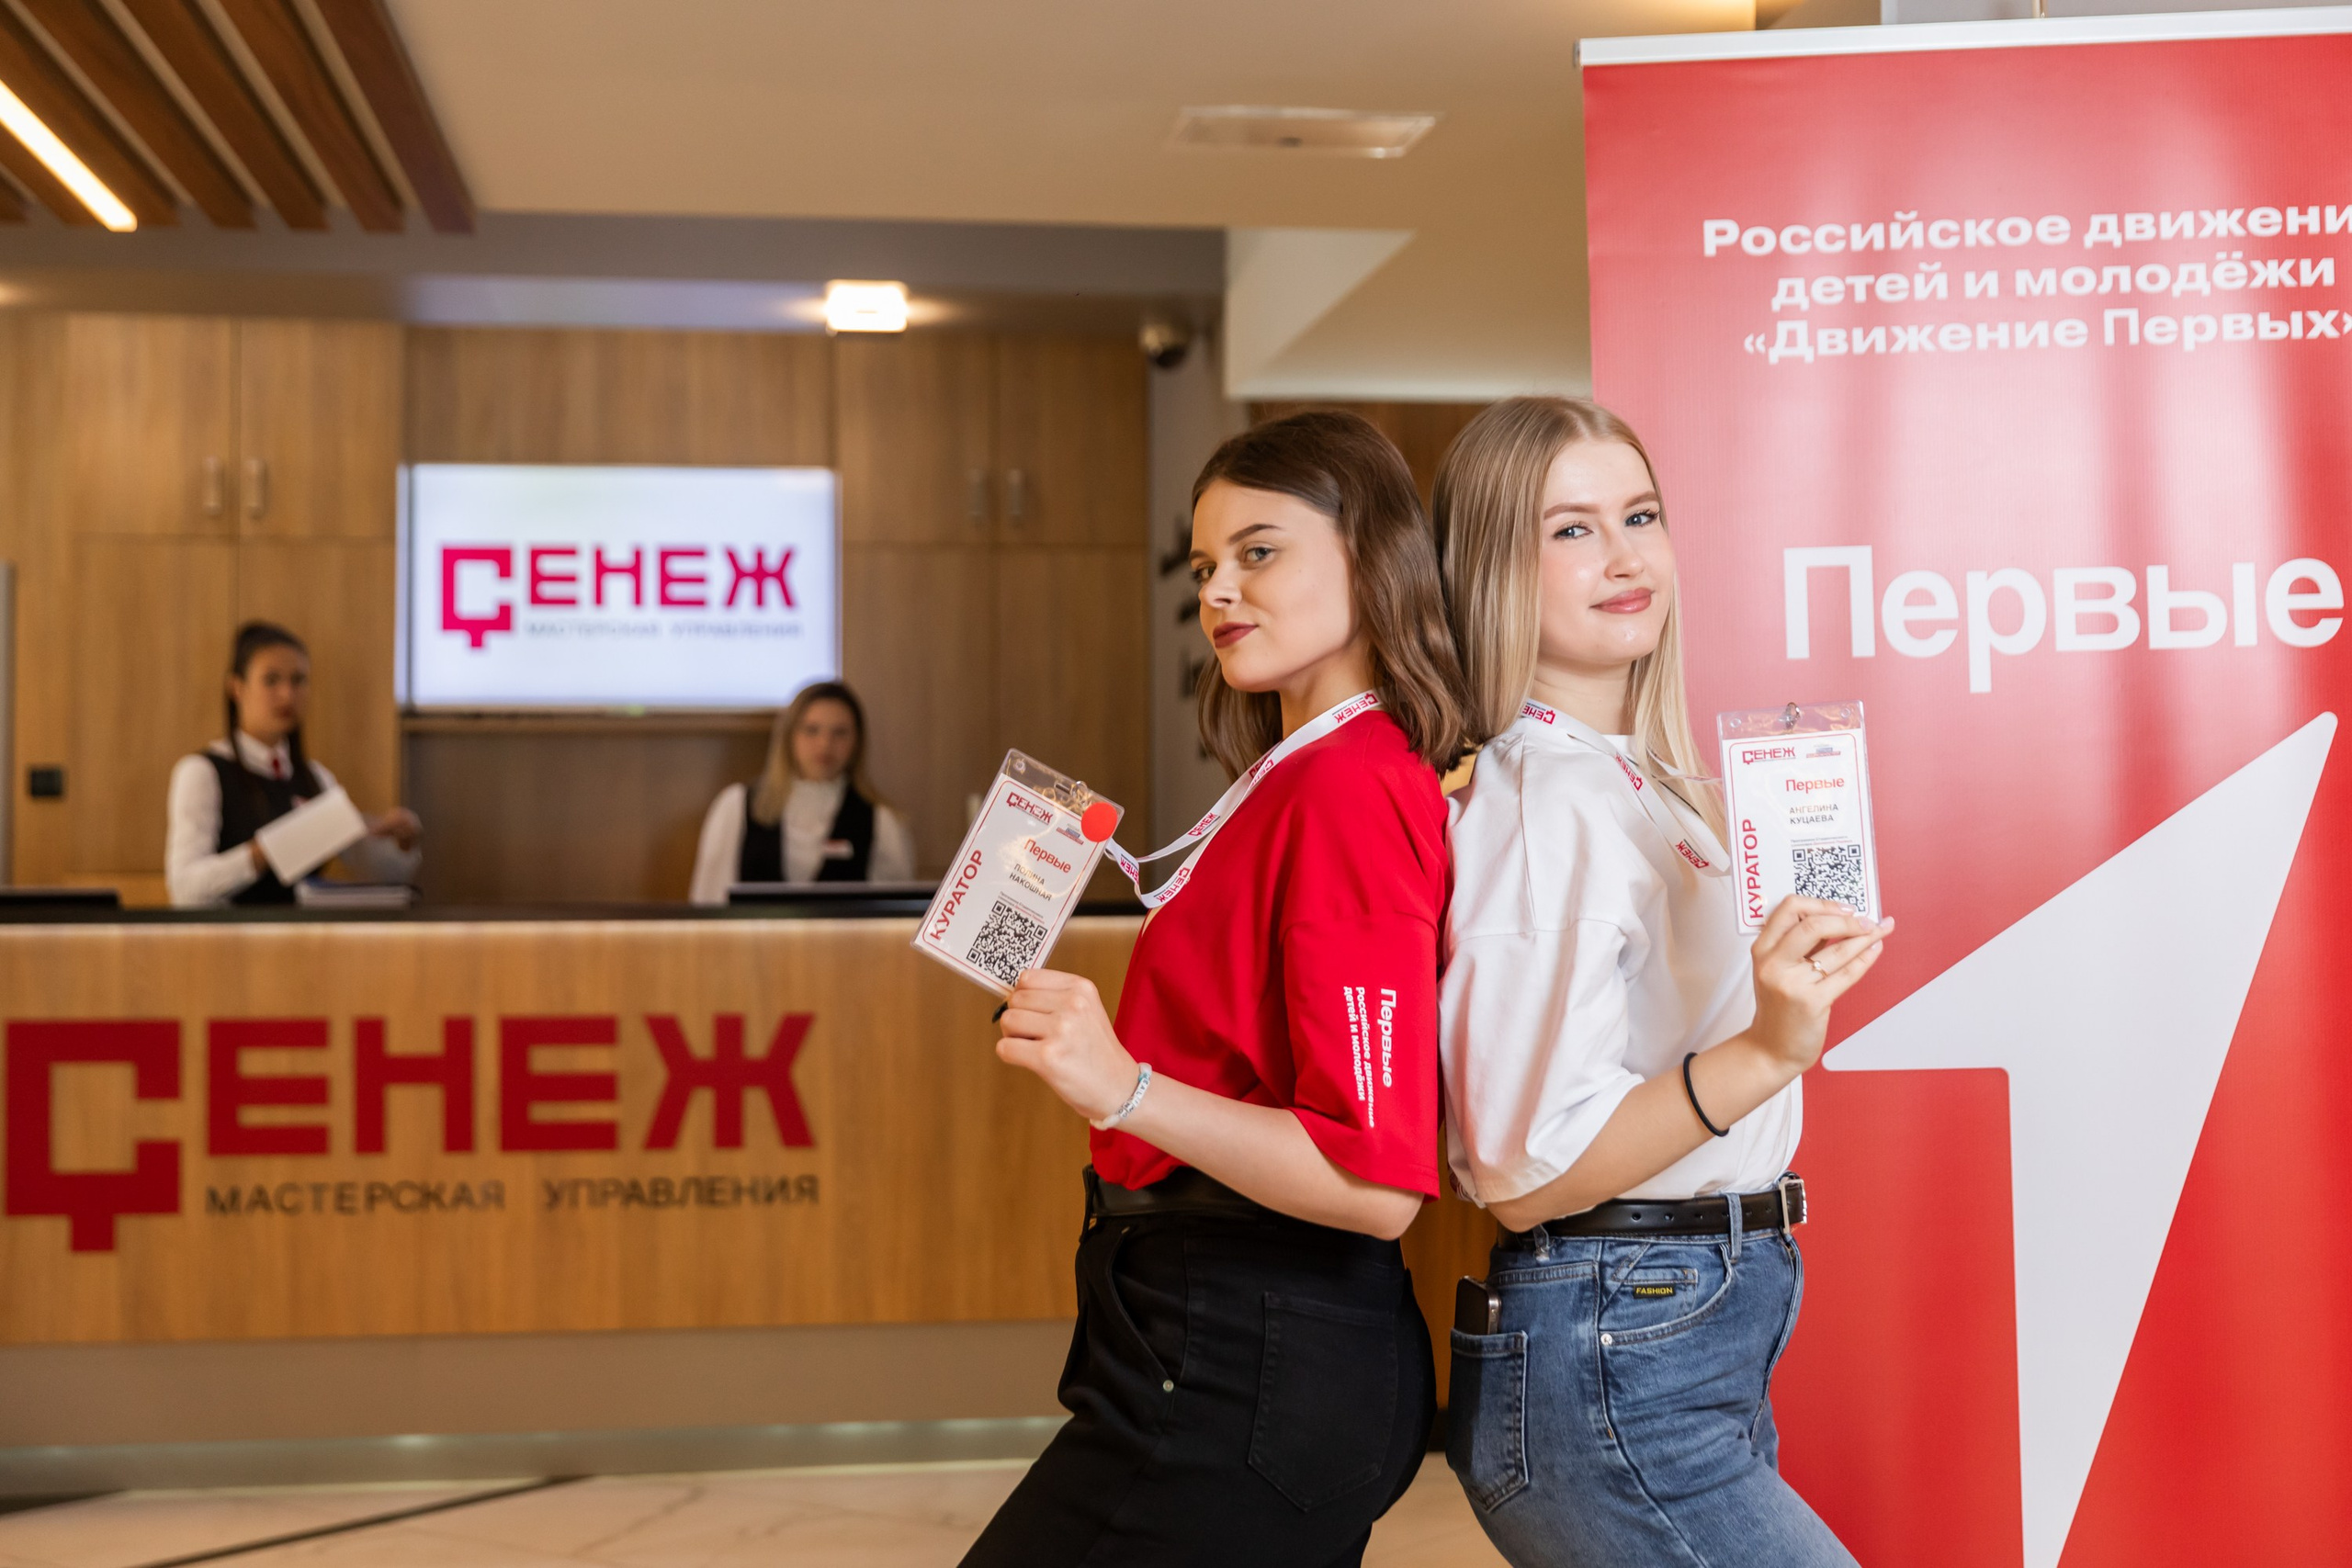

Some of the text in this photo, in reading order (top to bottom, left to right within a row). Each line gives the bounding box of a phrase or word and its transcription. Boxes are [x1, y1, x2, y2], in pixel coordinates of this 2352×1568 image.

[1702, 204, 2352, 257] Российское движени
[1771, 252, 2335, 311] детей и молодёжи
[1744, 315, 2088, 365] «Движение
[442, 546, 797, 649] СЕНЕЖ
[1783, 546, 2345, 694] Первые
[1334, 693, 1379, 724] СЕНЕЖ
[1521, 705, 1556, 725] СЕНЕ
[1742, 746, 1796, 765] СЕНЕЖ
[1785, 777, 1845, 795] Первые
[1006, 791, 1054, 826] СЕНЕЖ
[1188, 813, 1217, 836] СЕНЕЖ
[1789, 804, 1839, 815] АНГЕЛИНА
[1790, 815, 1834, 825] КУЦАЕВА
[1023, 839, 1071, 874] Первые
[1120, 857, 1140, 885] ЕНЕЖ
[1742, 818, 1764, 919] КУРАТОР
[1009, 873, 1053, 902] НАКОШНАЯ
[1013, 863, 1045, 886] ПОЛИНА
[1156, 867, 1191, 903] СЕНЕЖ
[930, 849, 983, 941] КУРАТОР
[1355, 986, 1371, 1059] Российское
[1377, 987, 1396, 1089] Первые
[1343, 986, 1365, 1101] детей и молодёжи
[4, 1011, 818, 1254] СЕНЕЖ
[205, 1174, 820, 1218] МАСТЕРСКАЯ УПРАВЛЕНИЯ
[1635, 1286, 1674, 1295] FASHION
